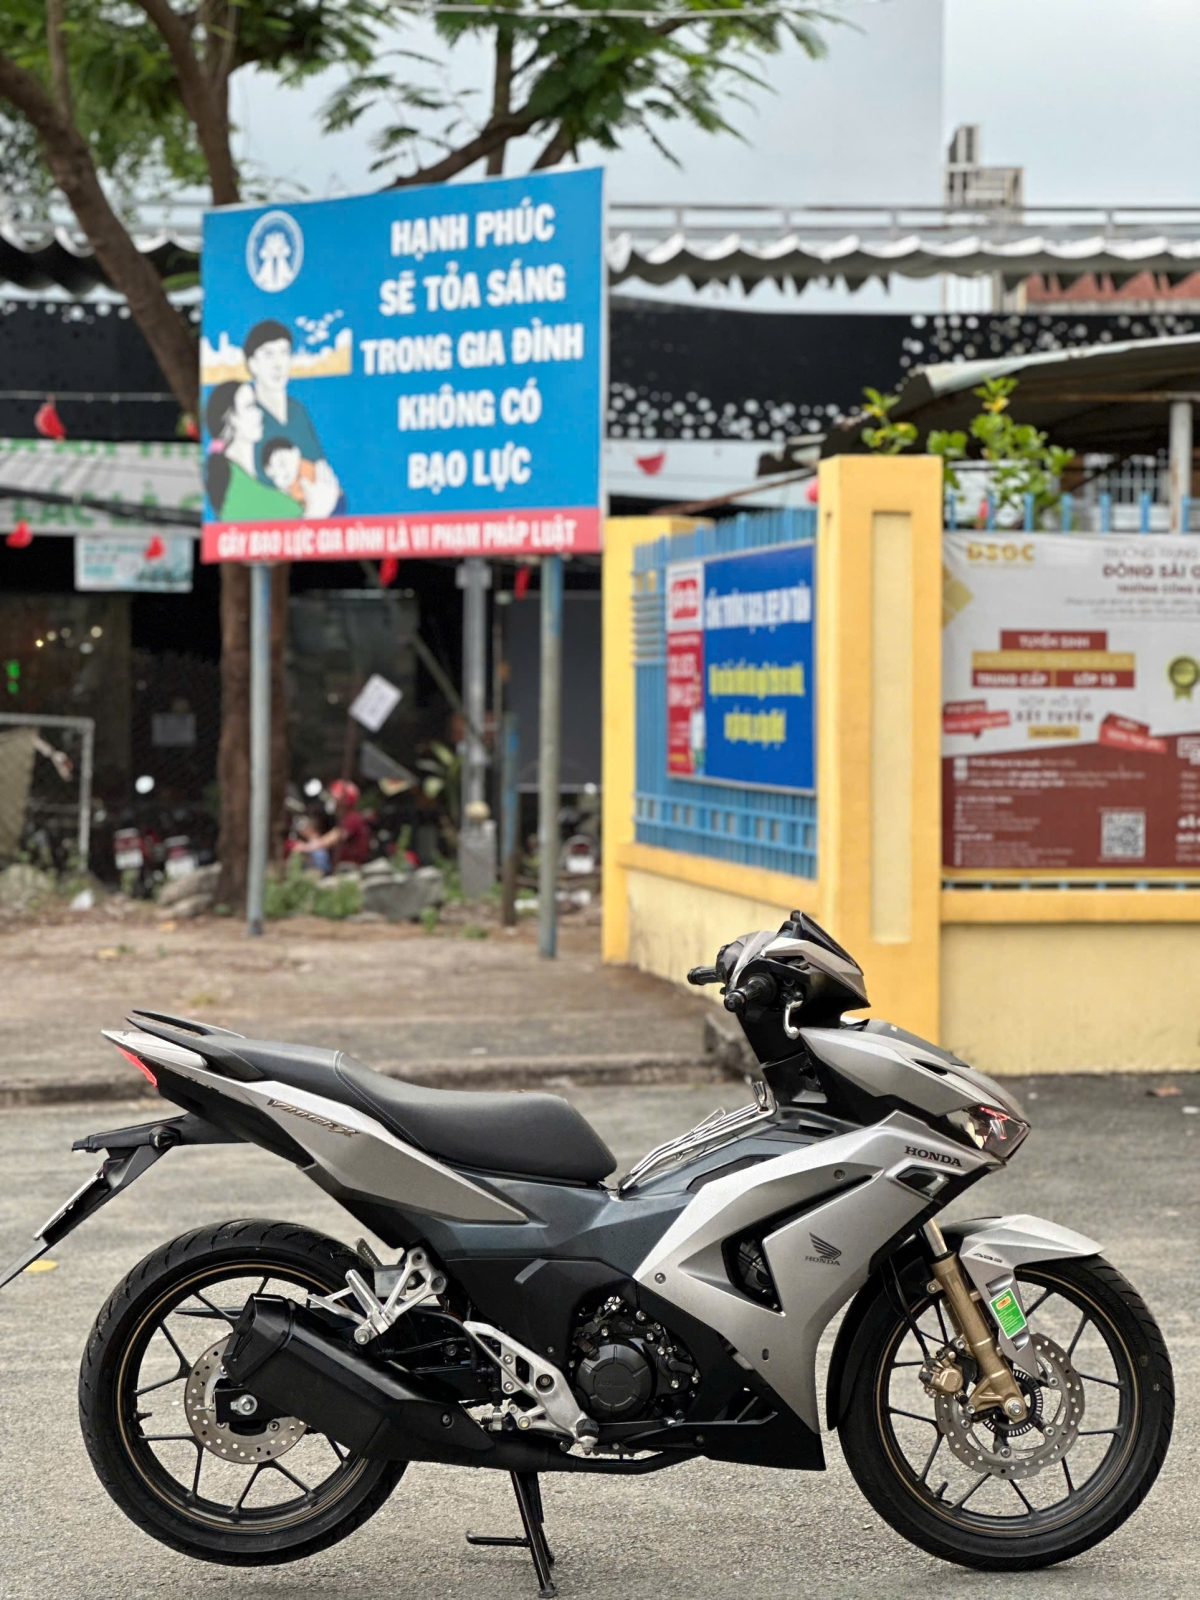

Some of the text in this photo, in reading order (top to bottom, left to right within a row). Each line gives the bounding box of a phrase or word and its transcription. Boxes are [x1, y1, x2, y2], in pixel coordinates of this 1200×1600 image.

[391, 197, 555, 261] HẠNH PHÚC
[379, 258, 566, 316] SẼ TỎA SÁNG
[360, 318, 583, 375] TRONG GIA ĐÌNH
[397, 377, 542, 432] KHÔNG CÓ
[408, 441, 532, 495] BẠO LỰC
[249, 529, 282, 560] BẠO
[316, 527, 343, 555] GIA
[904, 1145, 962, 1168] HONDA
[804, 1255, 841, 1266] HONDA
